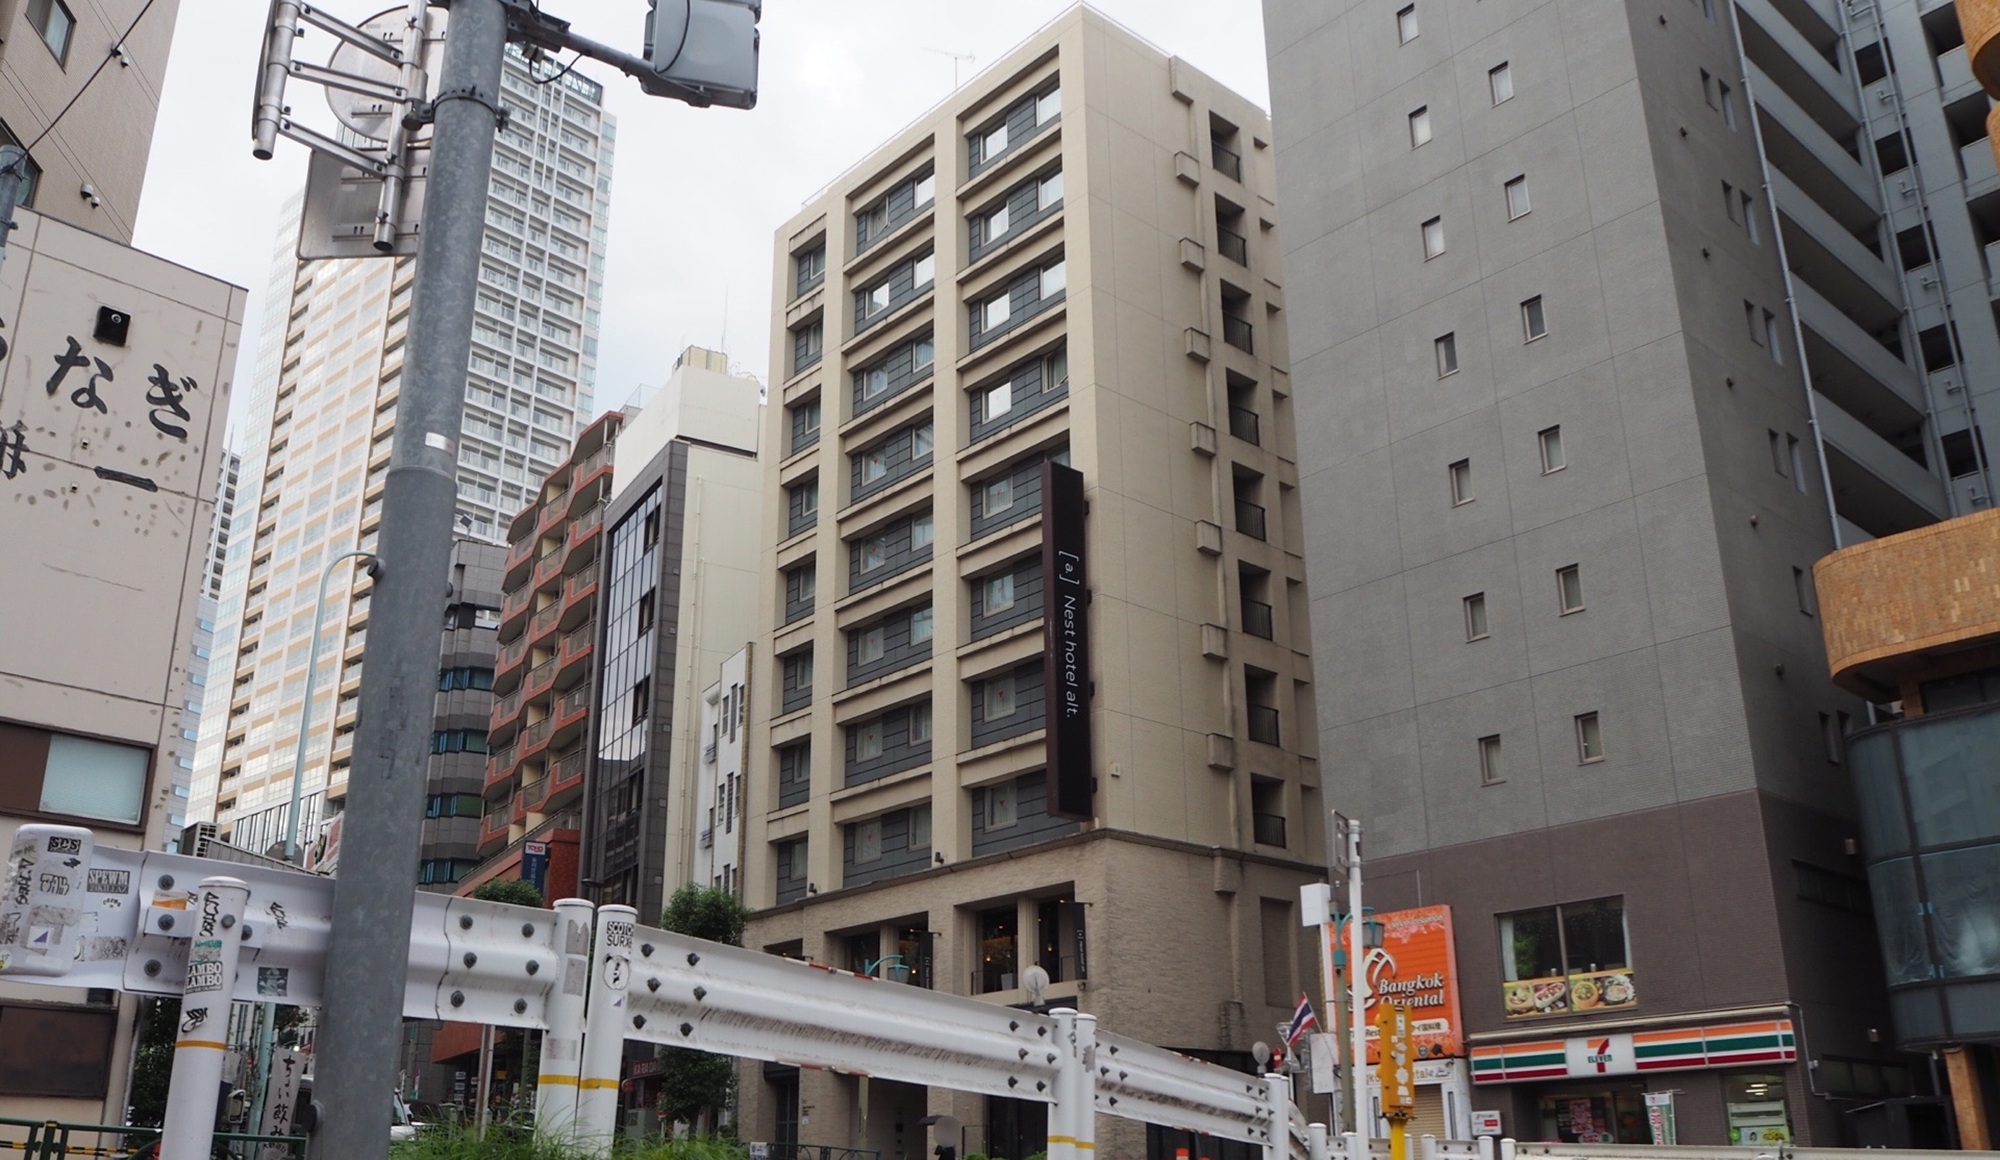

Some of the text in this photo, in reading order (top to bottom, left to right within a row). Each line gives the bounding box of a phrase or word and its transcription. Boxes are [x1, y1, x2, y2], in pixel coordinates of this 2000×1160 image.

[1064, 594, 1076, 637] Nest
[1065, 640, 1078, 687] hotel
[1066, 690, 1079, 718] alt.
[1378, 972, 1444, 995] Bangkok
